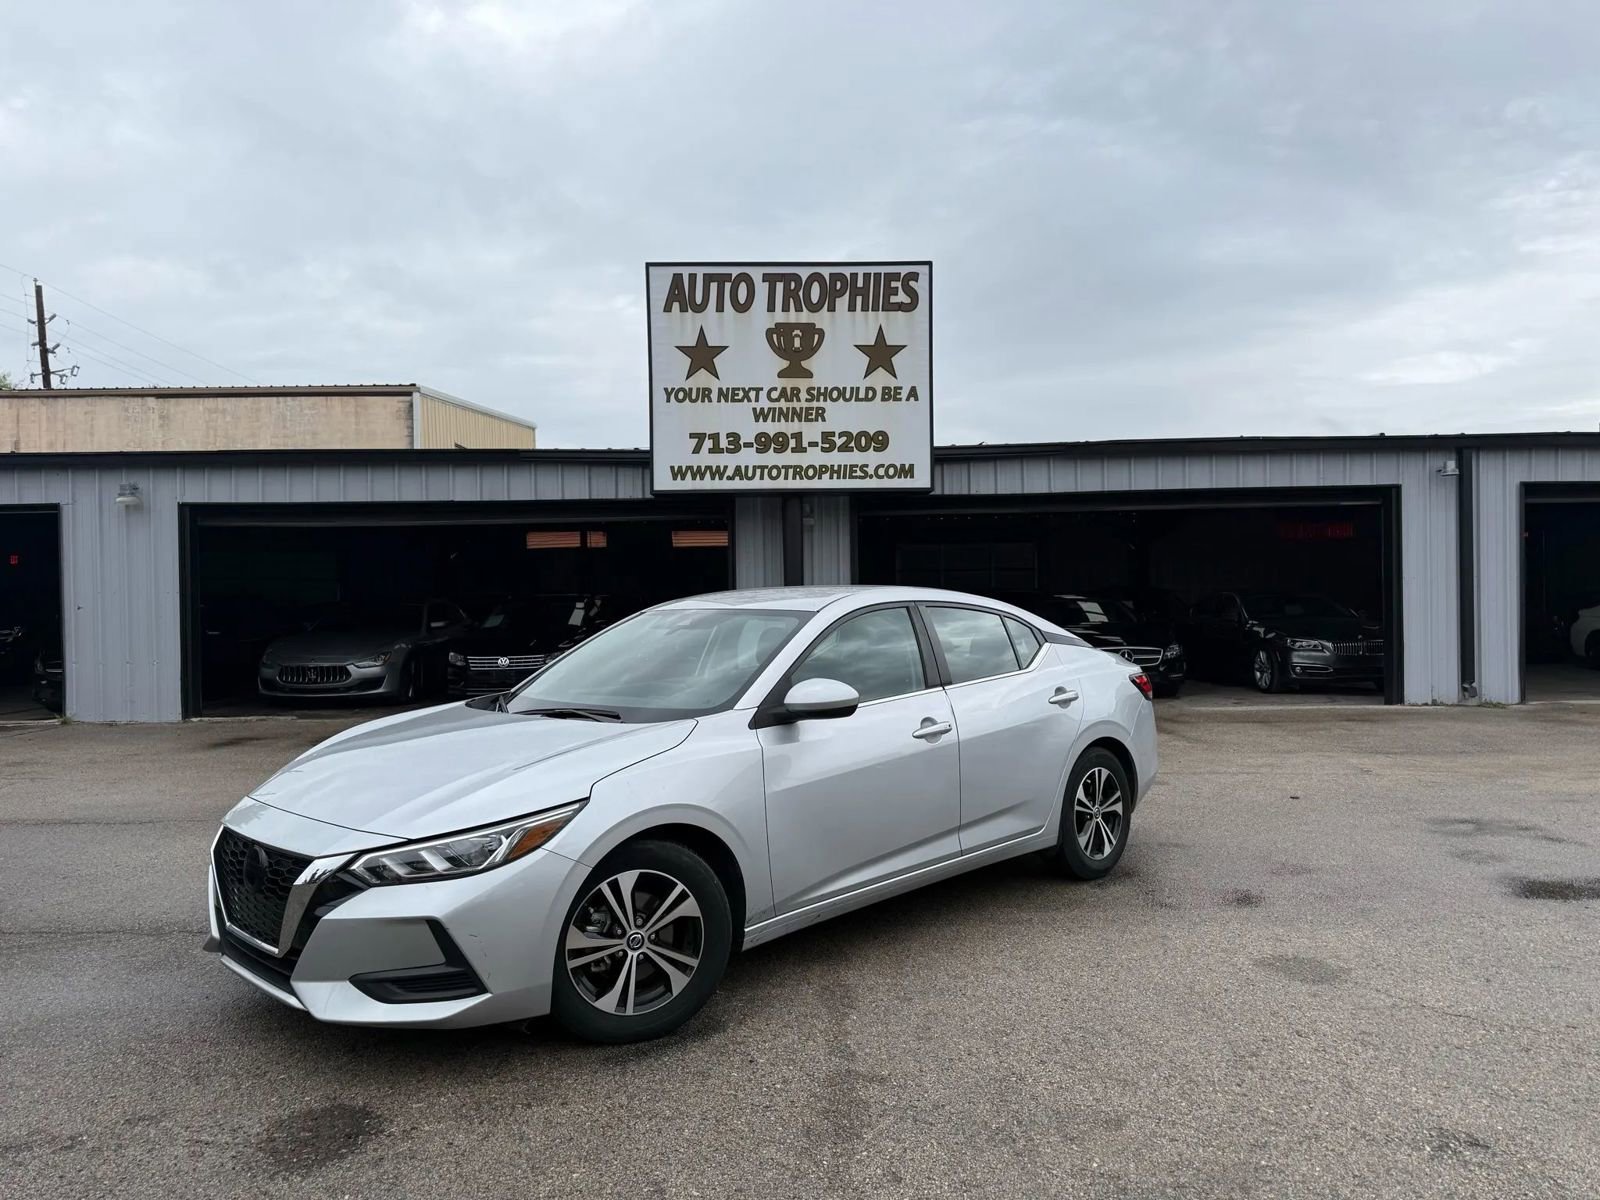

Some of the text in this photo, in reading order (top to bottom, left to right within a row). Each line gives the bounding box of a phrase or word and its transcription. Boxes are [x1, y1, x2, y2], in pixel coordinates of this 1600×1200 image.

[663, 271, 920, 313] AUTO TROPHIES
[664, 386, 919, 403] YOUR NEXT CAR SHOULD BE A
[752, 407, 826, 423] WINNER
[689, 431, 889, 454] 713-991-5209
[670, 464, 915, 481] WWW.AUTOTROPHIES.COM
